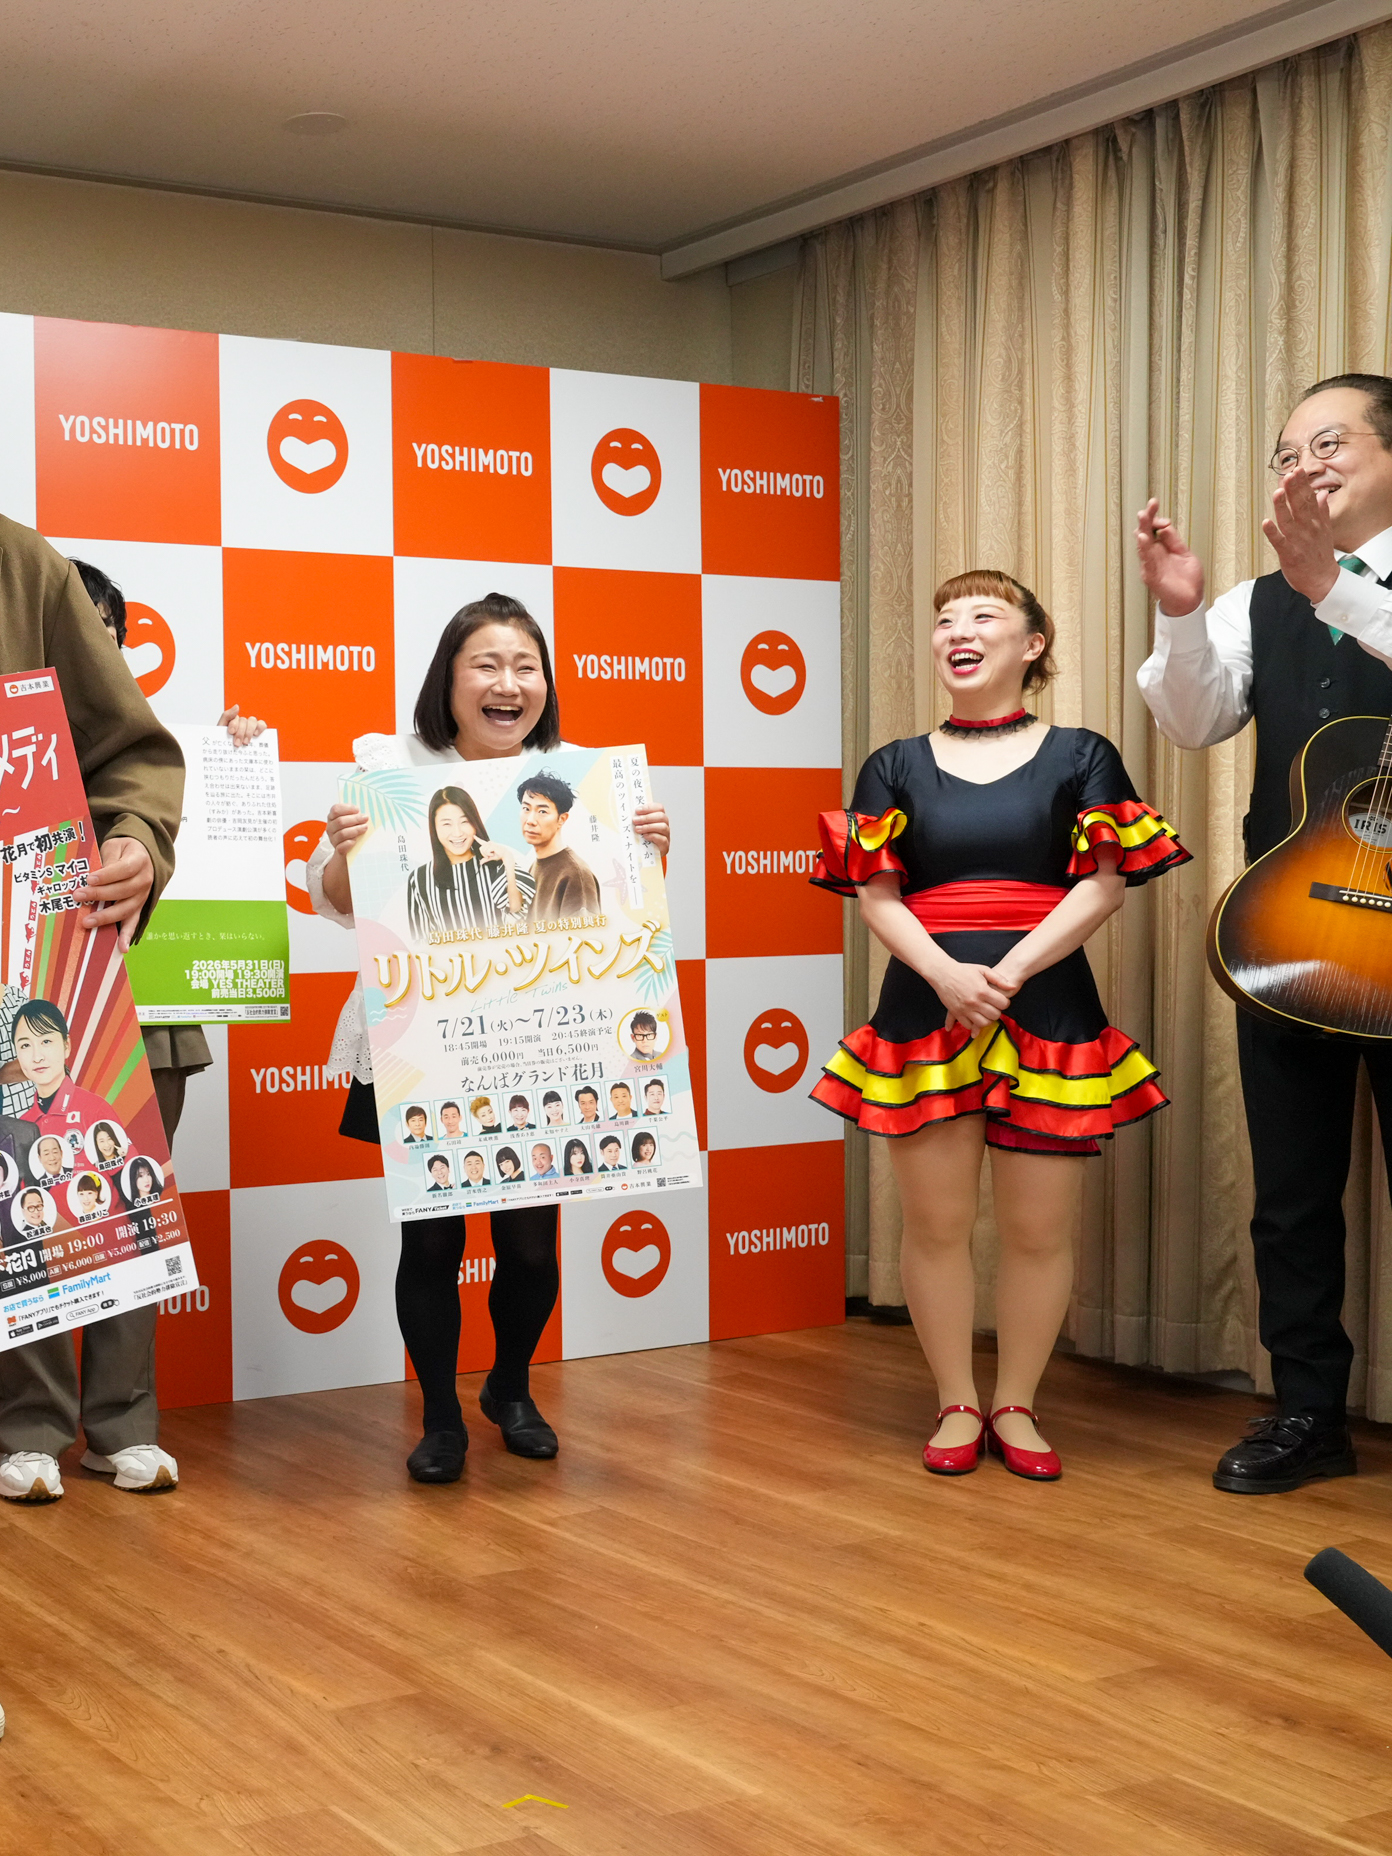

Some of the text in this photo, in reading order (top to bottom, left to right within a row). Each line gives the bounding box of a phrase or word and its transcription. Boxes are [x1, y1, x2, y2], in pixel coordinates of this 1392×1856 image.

[59, 414, 200, 451] YOSHIMOTO
[412, 443, 533, 477] YOSHIMOTO
[718, 468, 824, 499] YOSHIMOTO
[245, 642, 376, 672] YOSHIMOTO
[573, 654, 686, 682] YOSHIMOTO
[202, 736, 210, 746] 父
[589, 815, 601, 842] 藤井隆
[1354, 818, 1388, 834] IRIS
[397, 835, 410, 872] 島田珠代
[723, 849, 815, 875] YOSHIMOT
[14, 868, 53, 883] ビタミンS
[55, 859, 89, 875] マイコ
[37, 878, 77, 895] ギャロップ
[428, 915, 607, 945] 島田珠代 藤井隆 夏の特別興行
[192, 960, 285, 970] 2026年5月31日(日)
[374, 920, 664, 1007] リトル・ツインズ
[211, 979, 233, 988] YES
[236, 979, 284, 988] THEATER
[211, 988, 285, 998] 前売当日3,500円
[470, 982, 568, 1013] Little Twins
[444, 1026, 613, 1053] 18:45開場 19:15開演 20:45終演予定
[250, 1065, 354, 1093] YOSHIMO
[461, 1061, 604, 1093] なんばグランド花月
[473, 1199, 499, 1207] FamilyMart
[39, 1245, 64, 1263] 開場
[67, 1233, 105, 1254] 19:00
[115, 1222, 140, 1240] 開演
[143, 1211, 178, 1232] 19:30
[726, 1223, 829, 1255] YOSHIMOTO
[3, 1295, 44, 1312] お店で買うなら
[62, 1272, 111, 1295] FamilyMart
